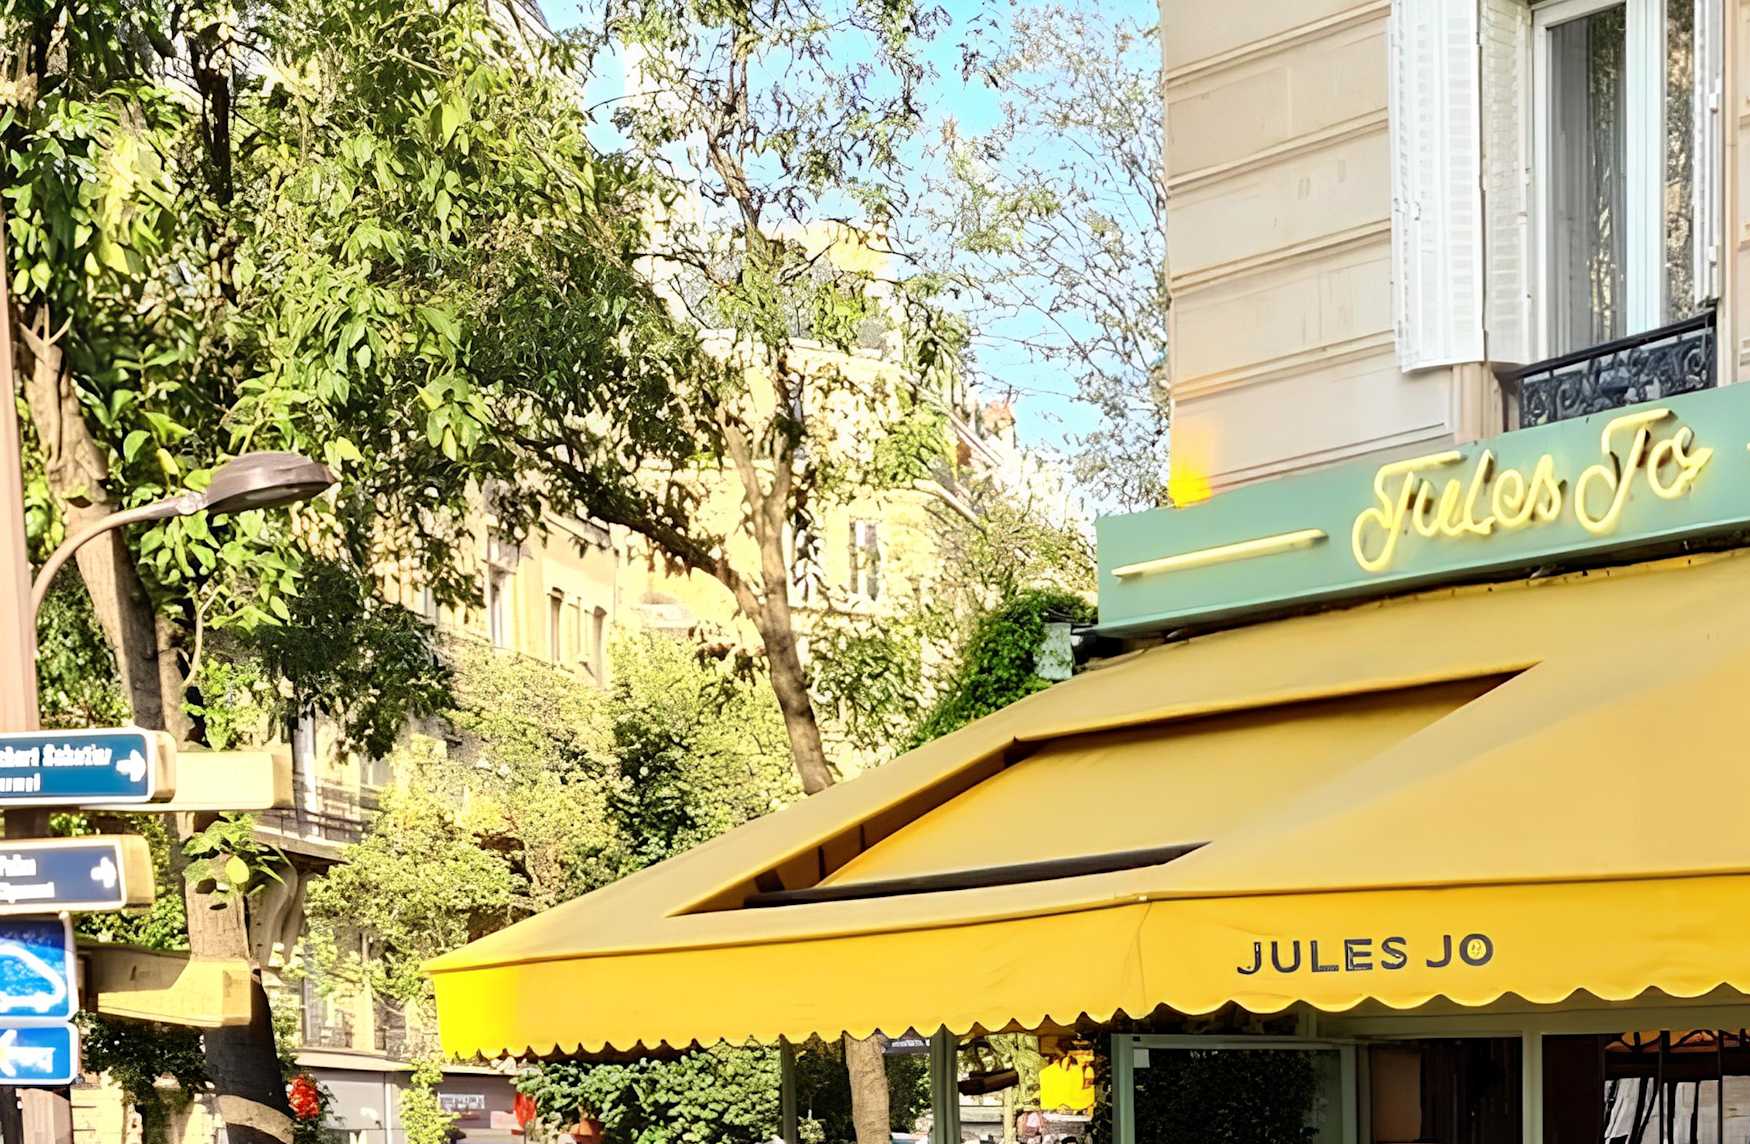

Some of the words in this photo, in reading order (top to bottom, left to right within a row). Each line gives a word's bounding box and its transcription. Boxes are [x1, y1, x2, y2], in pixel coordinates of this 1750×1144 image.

[1351, 448, 1564, 571] Jules
[1575, 408, 1712, 534] Jo
[1236, 936, 1408, 976] JULES
[1426, 933, 1494, 968] JO
